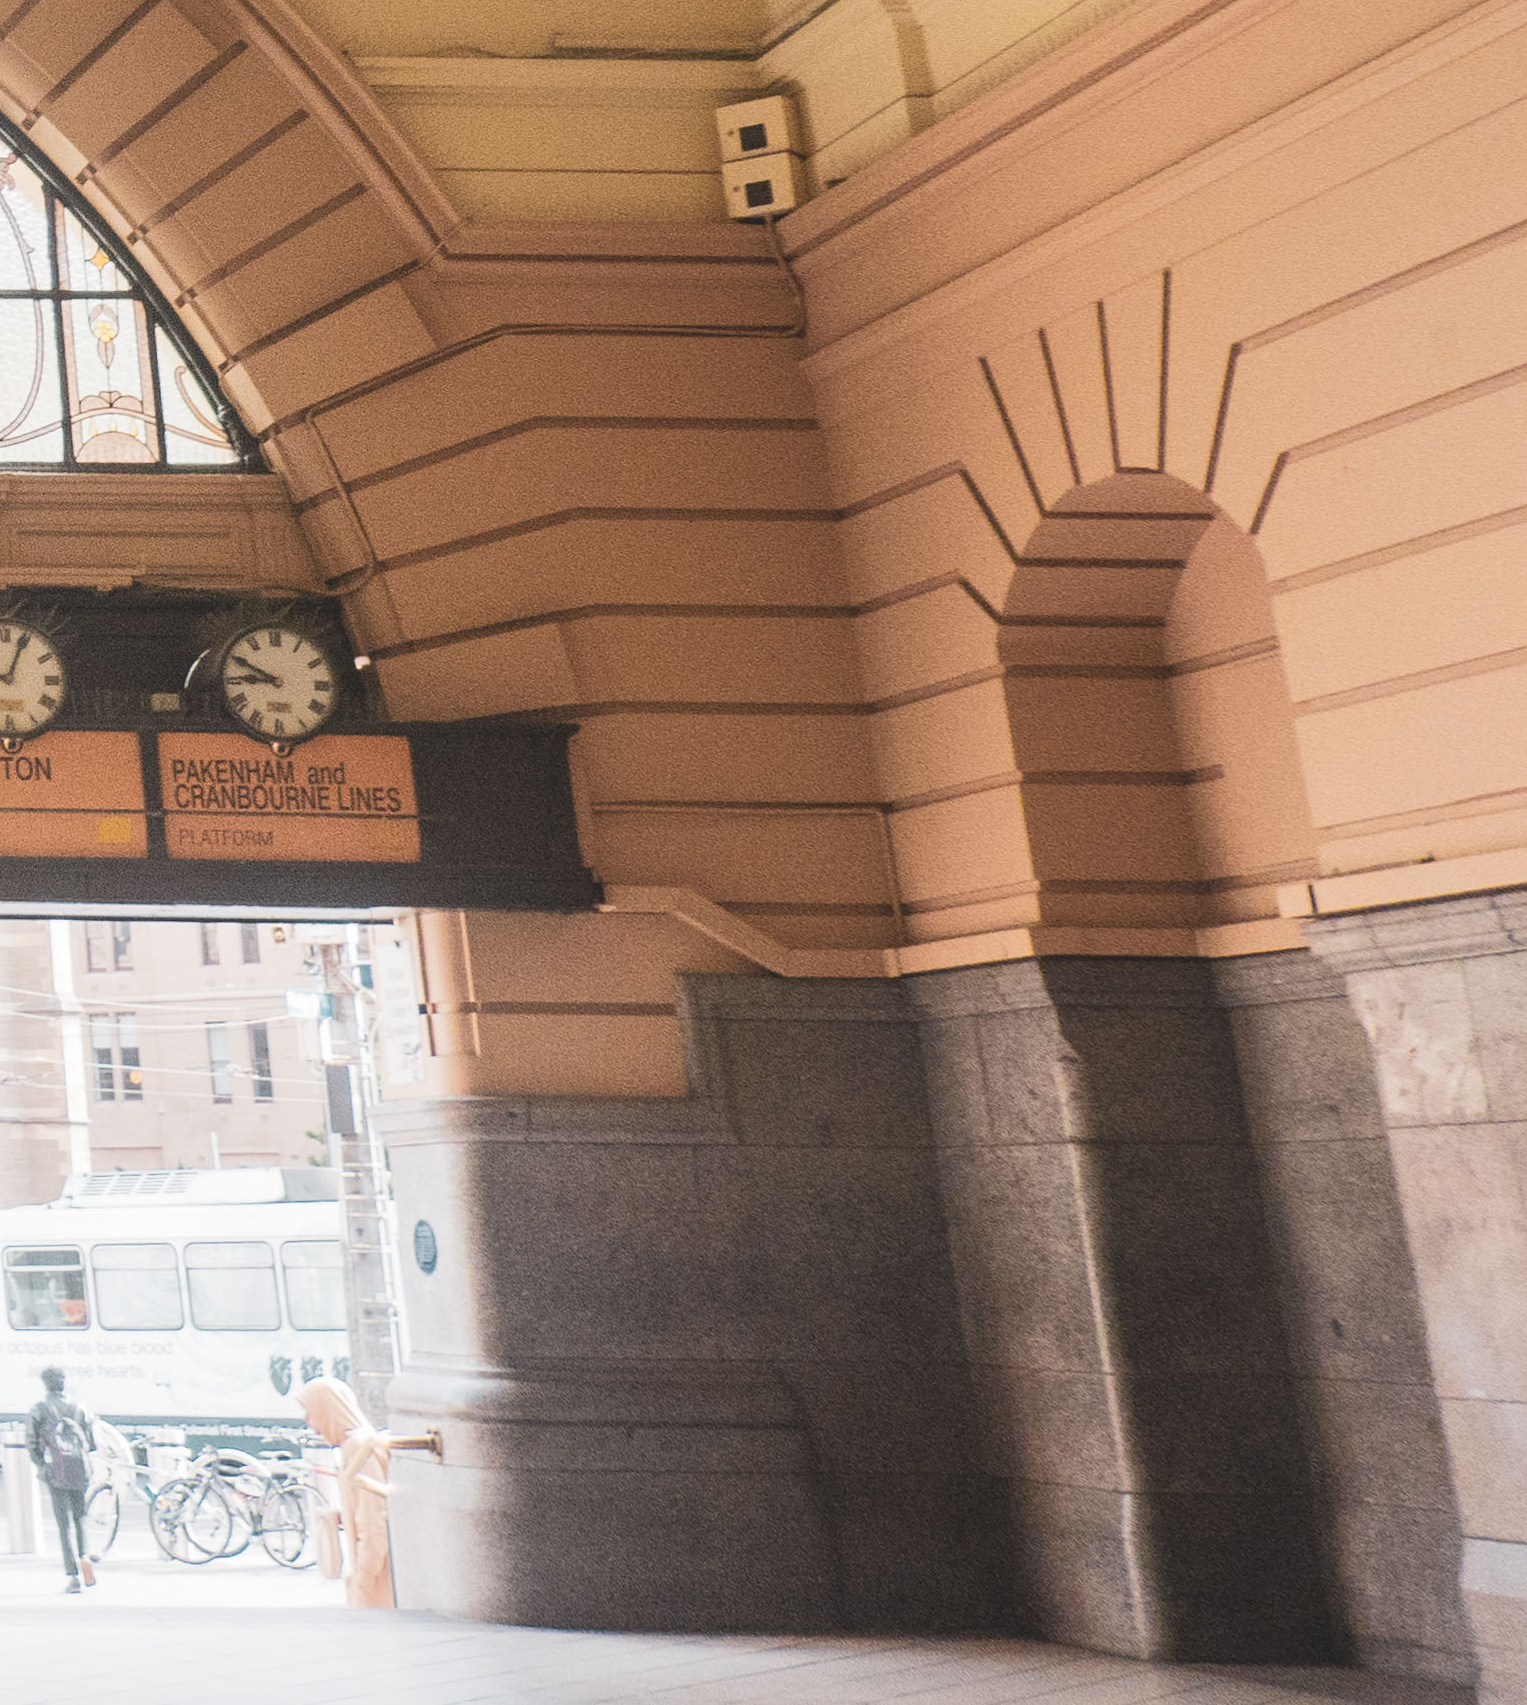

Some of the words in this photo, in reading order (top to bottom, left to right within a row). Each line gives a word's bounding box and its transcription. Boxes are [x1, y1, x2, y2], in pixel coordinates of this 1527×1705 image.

[172, 759, 294, 784] PAKENHAM
[307, 762, 346, 786] and
[175, 784, 331, 811] CRANBOURNE
[337, 787, 402, 812] LINES
[178, 828, 274, 846] PLATFORM
